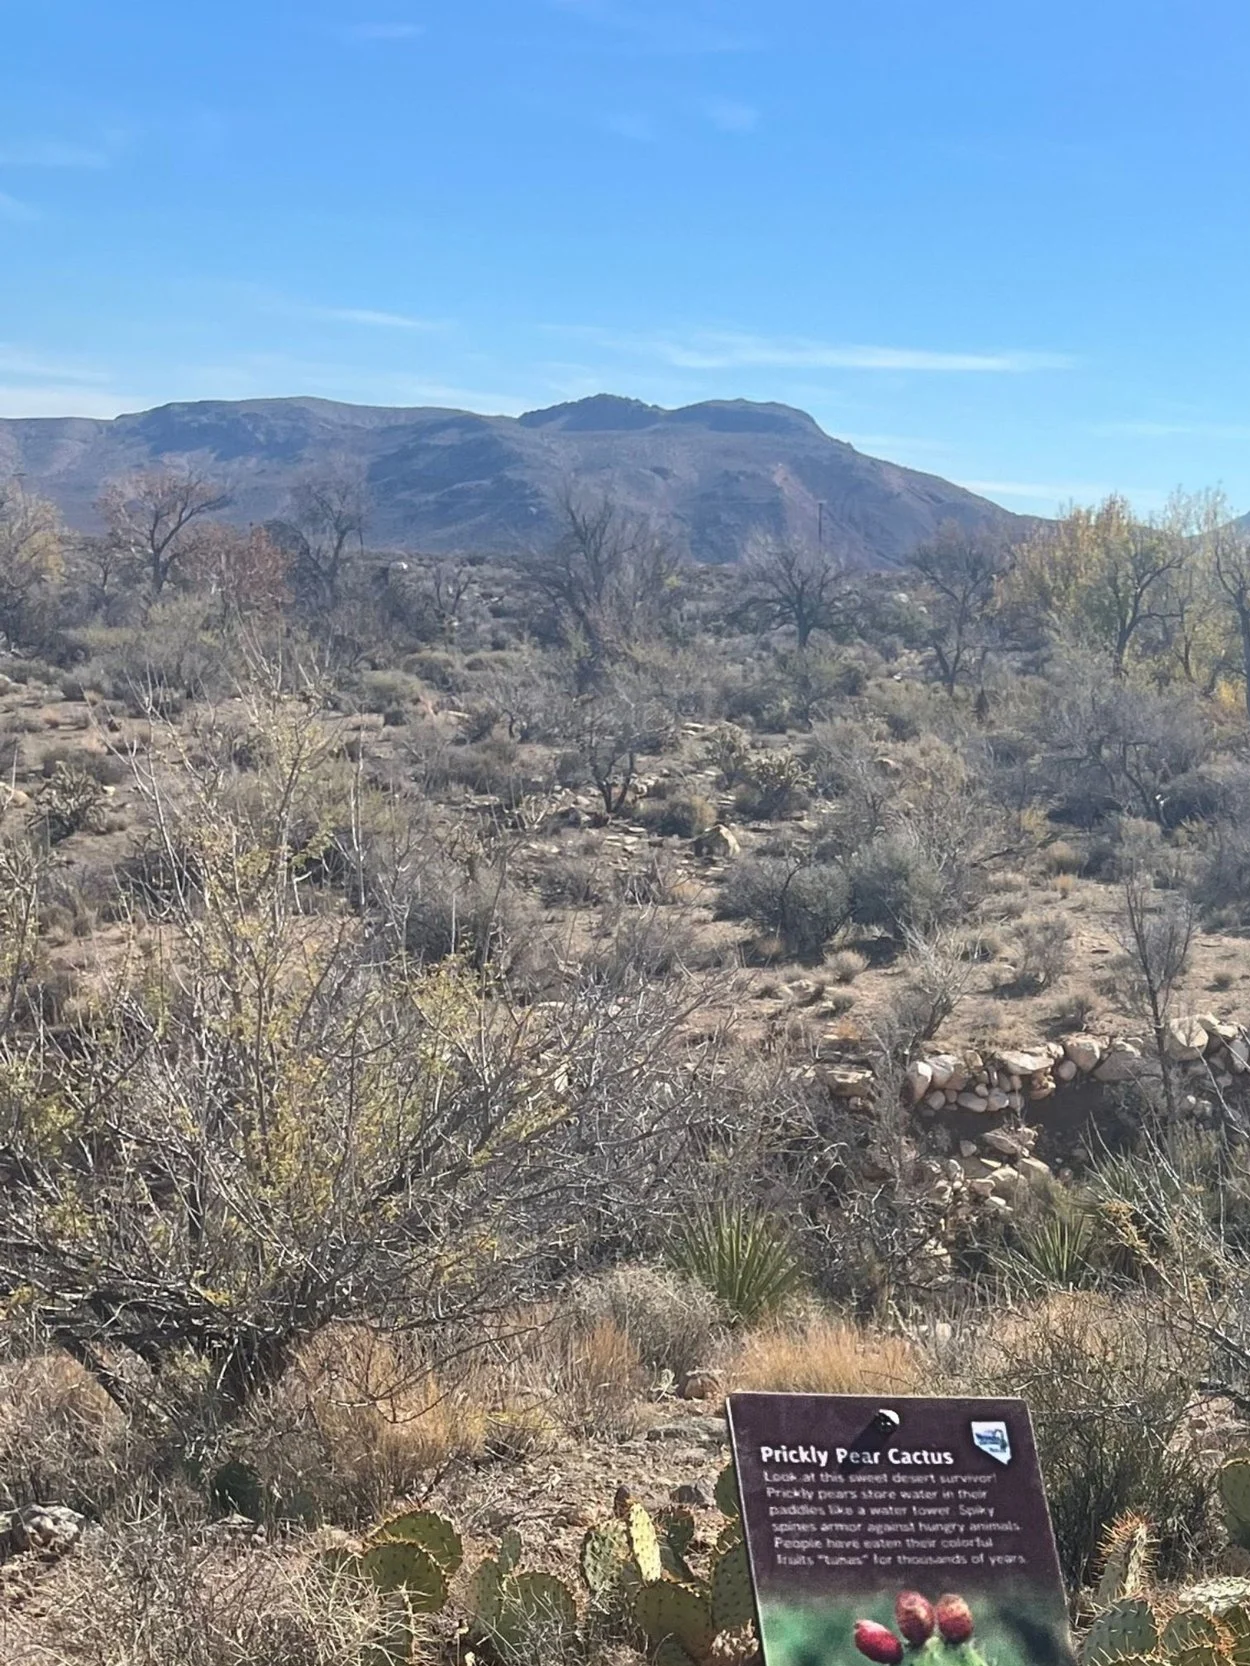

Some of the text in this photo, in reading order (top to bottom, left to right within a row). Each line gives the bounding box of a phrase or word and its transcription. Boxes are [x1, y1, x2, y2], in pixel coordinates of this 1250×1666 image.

[761, 1446, 954, 1466] Prickly Pear Cactus
[764, 1471, 798, 1482] Look
[802, 1472, 816, 1482] at
[820, 1472, 844, 1482] this
[849, 1472, 888, 1483] sweet
[892, 1472, 936, 1483] desert
[767, 1488, 987, 1500] Prickly pears store water in their
[770, 1505, 826, 1517] paddles
[829, 1505, 854, 1516] like
[858, 1508, 865, 1516] a
[870, 1506, 906, 1516] water
[820, 1523, 862, 1532] armor
[868, 1522, 914, 1533] against
[918, 1522, 964, 1533] hungry
[774, 1538, 993, 1550] People have eaten their colorful
[777, 1554, 814, 1565] fruits
[873, 1554, 892, 1564] for
[897, 1554, 967, 1564] thousands
[971, 1554, 984, 1564] of
